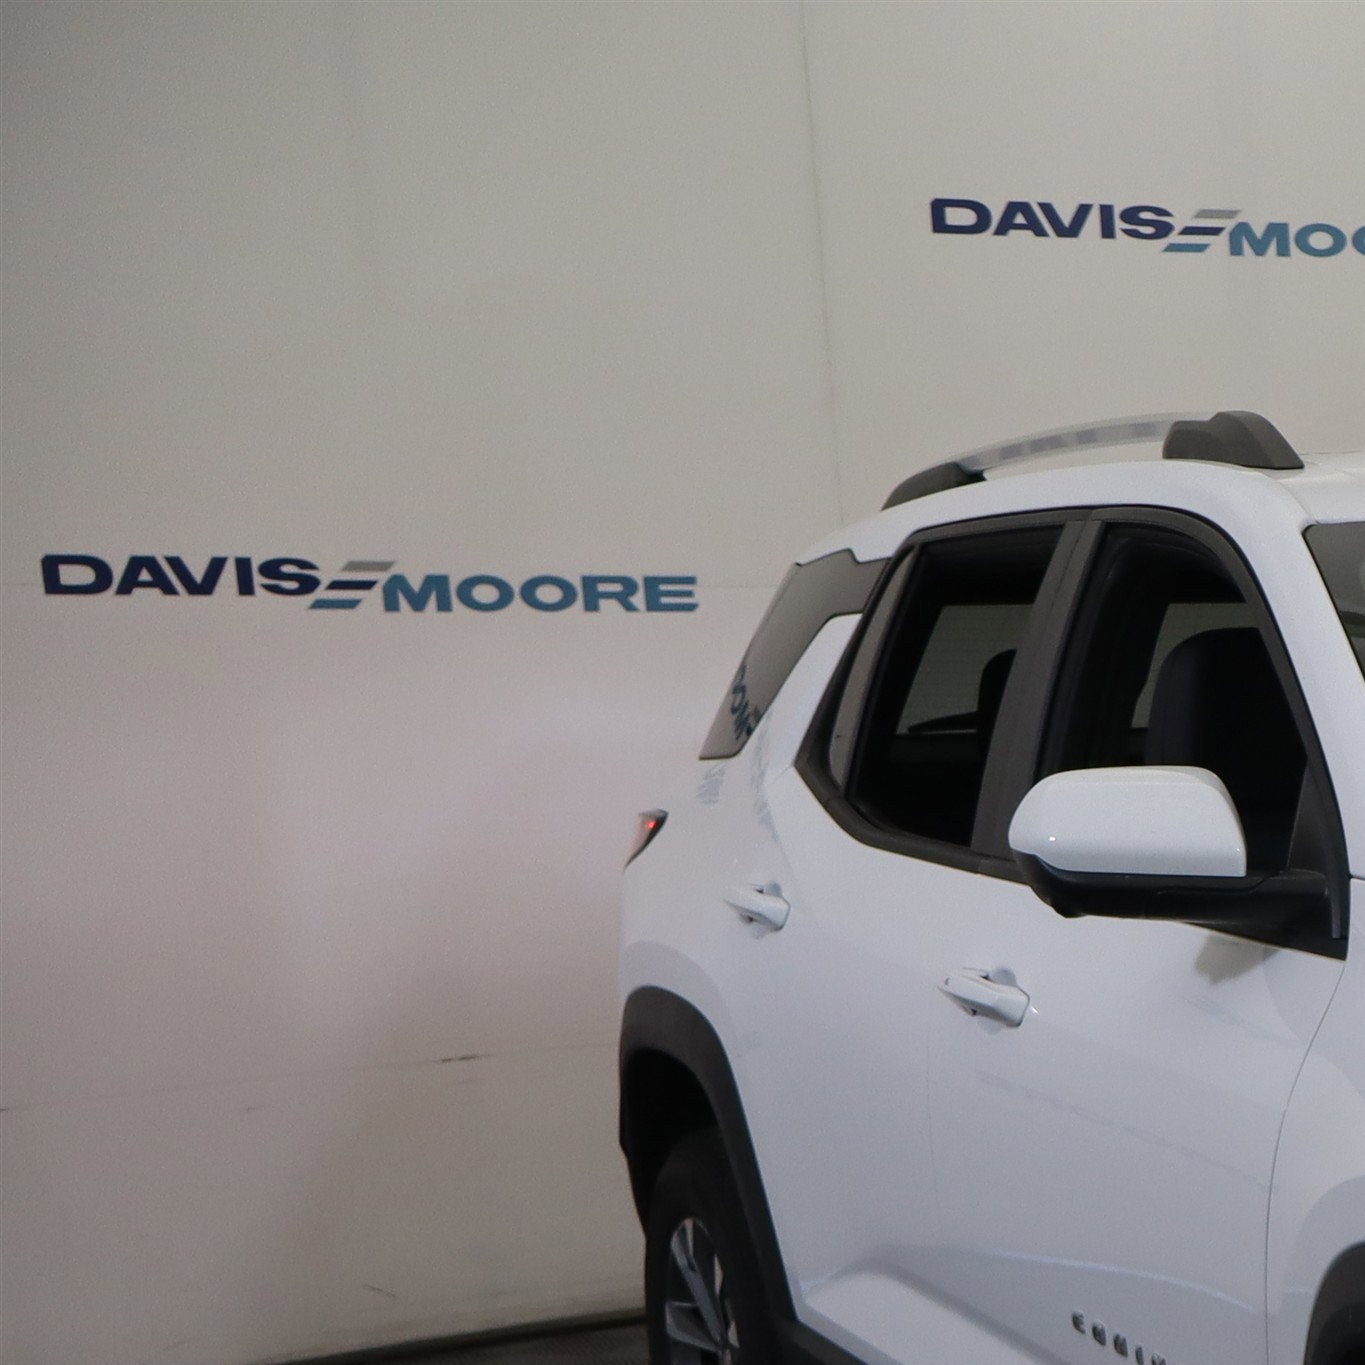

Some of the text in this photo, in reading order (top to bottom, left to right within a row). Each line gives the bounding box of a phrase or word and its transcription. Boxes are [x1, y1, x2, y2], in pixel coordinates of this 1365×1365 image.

[929, 197, 1175, 241] DAVIS
[40, 553, 699, 613] DAVIS MOORE
